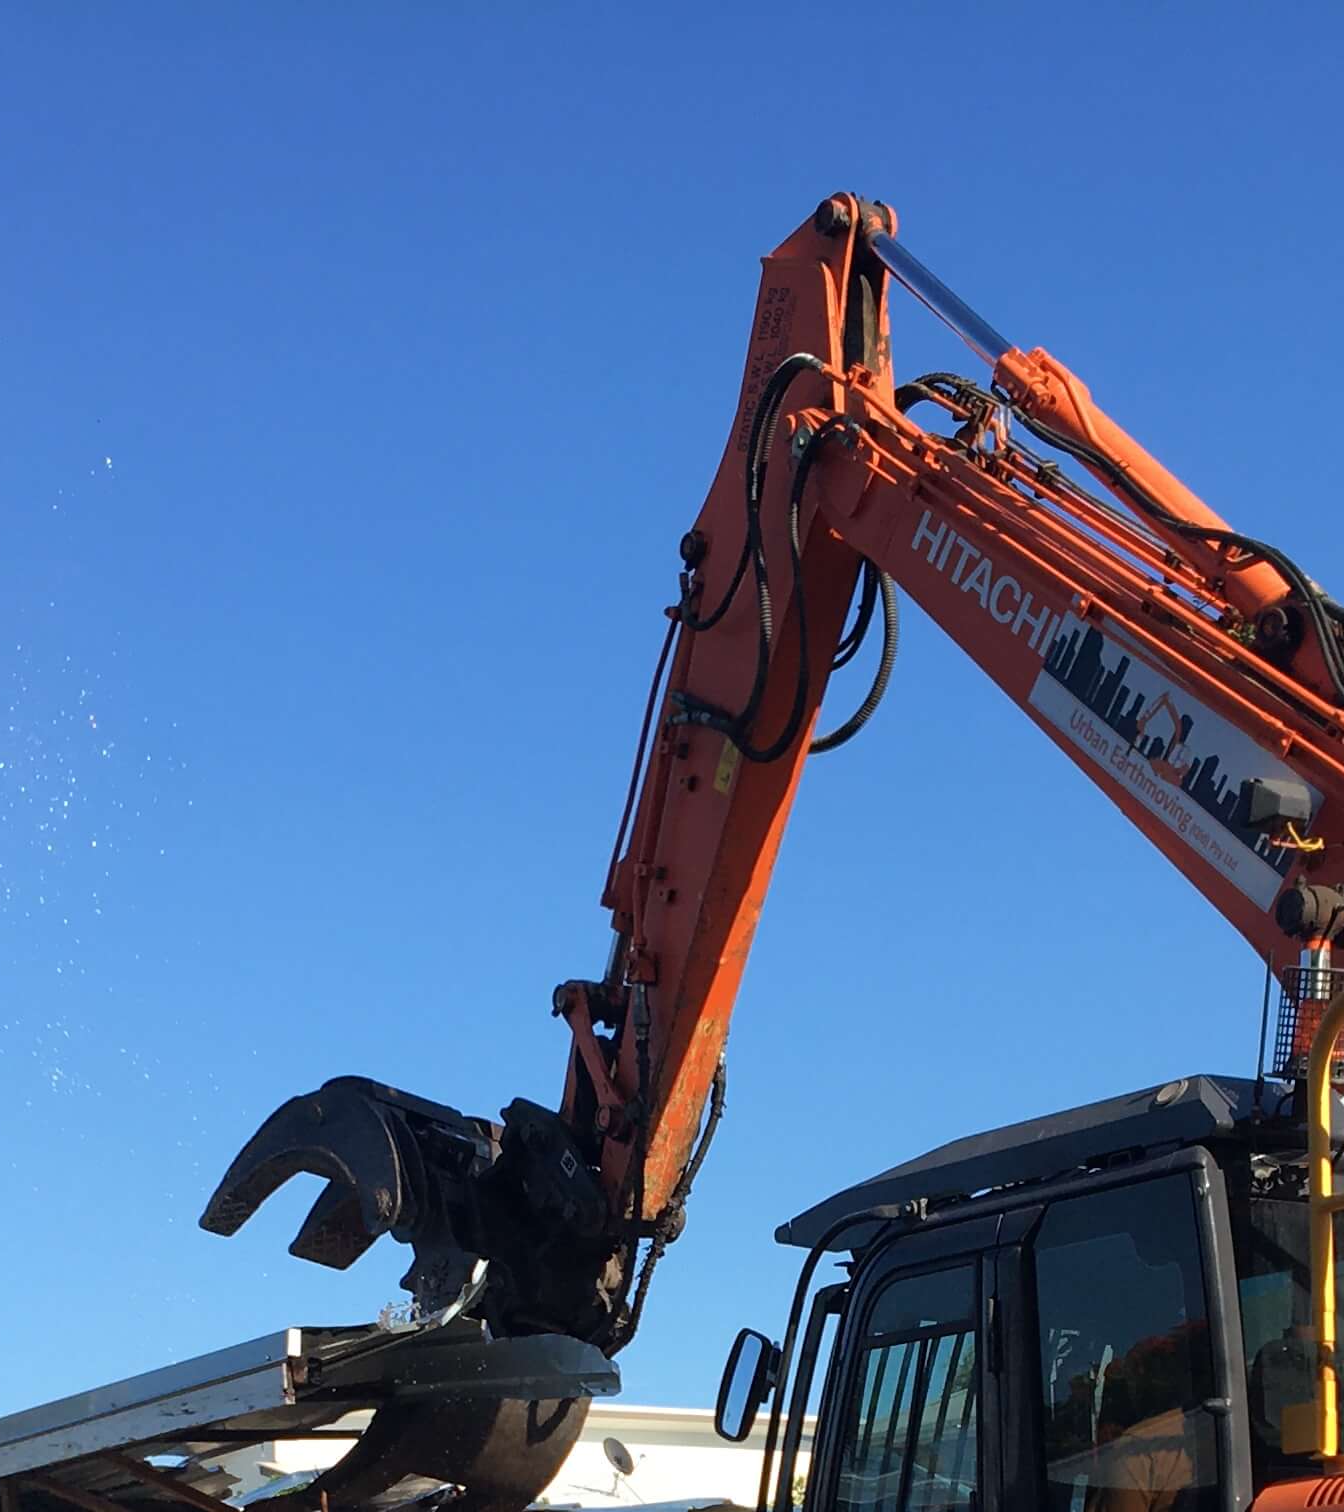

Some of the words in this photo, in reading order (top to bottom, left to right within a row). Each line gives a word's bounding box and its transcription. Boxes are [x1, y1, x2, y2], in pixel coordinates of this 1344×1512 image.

[911, 510, 1060, 657] HITACHI
[1070, 709, 1109, 755] Urban
[1110, 744, 1192, 832] Earthmoving
